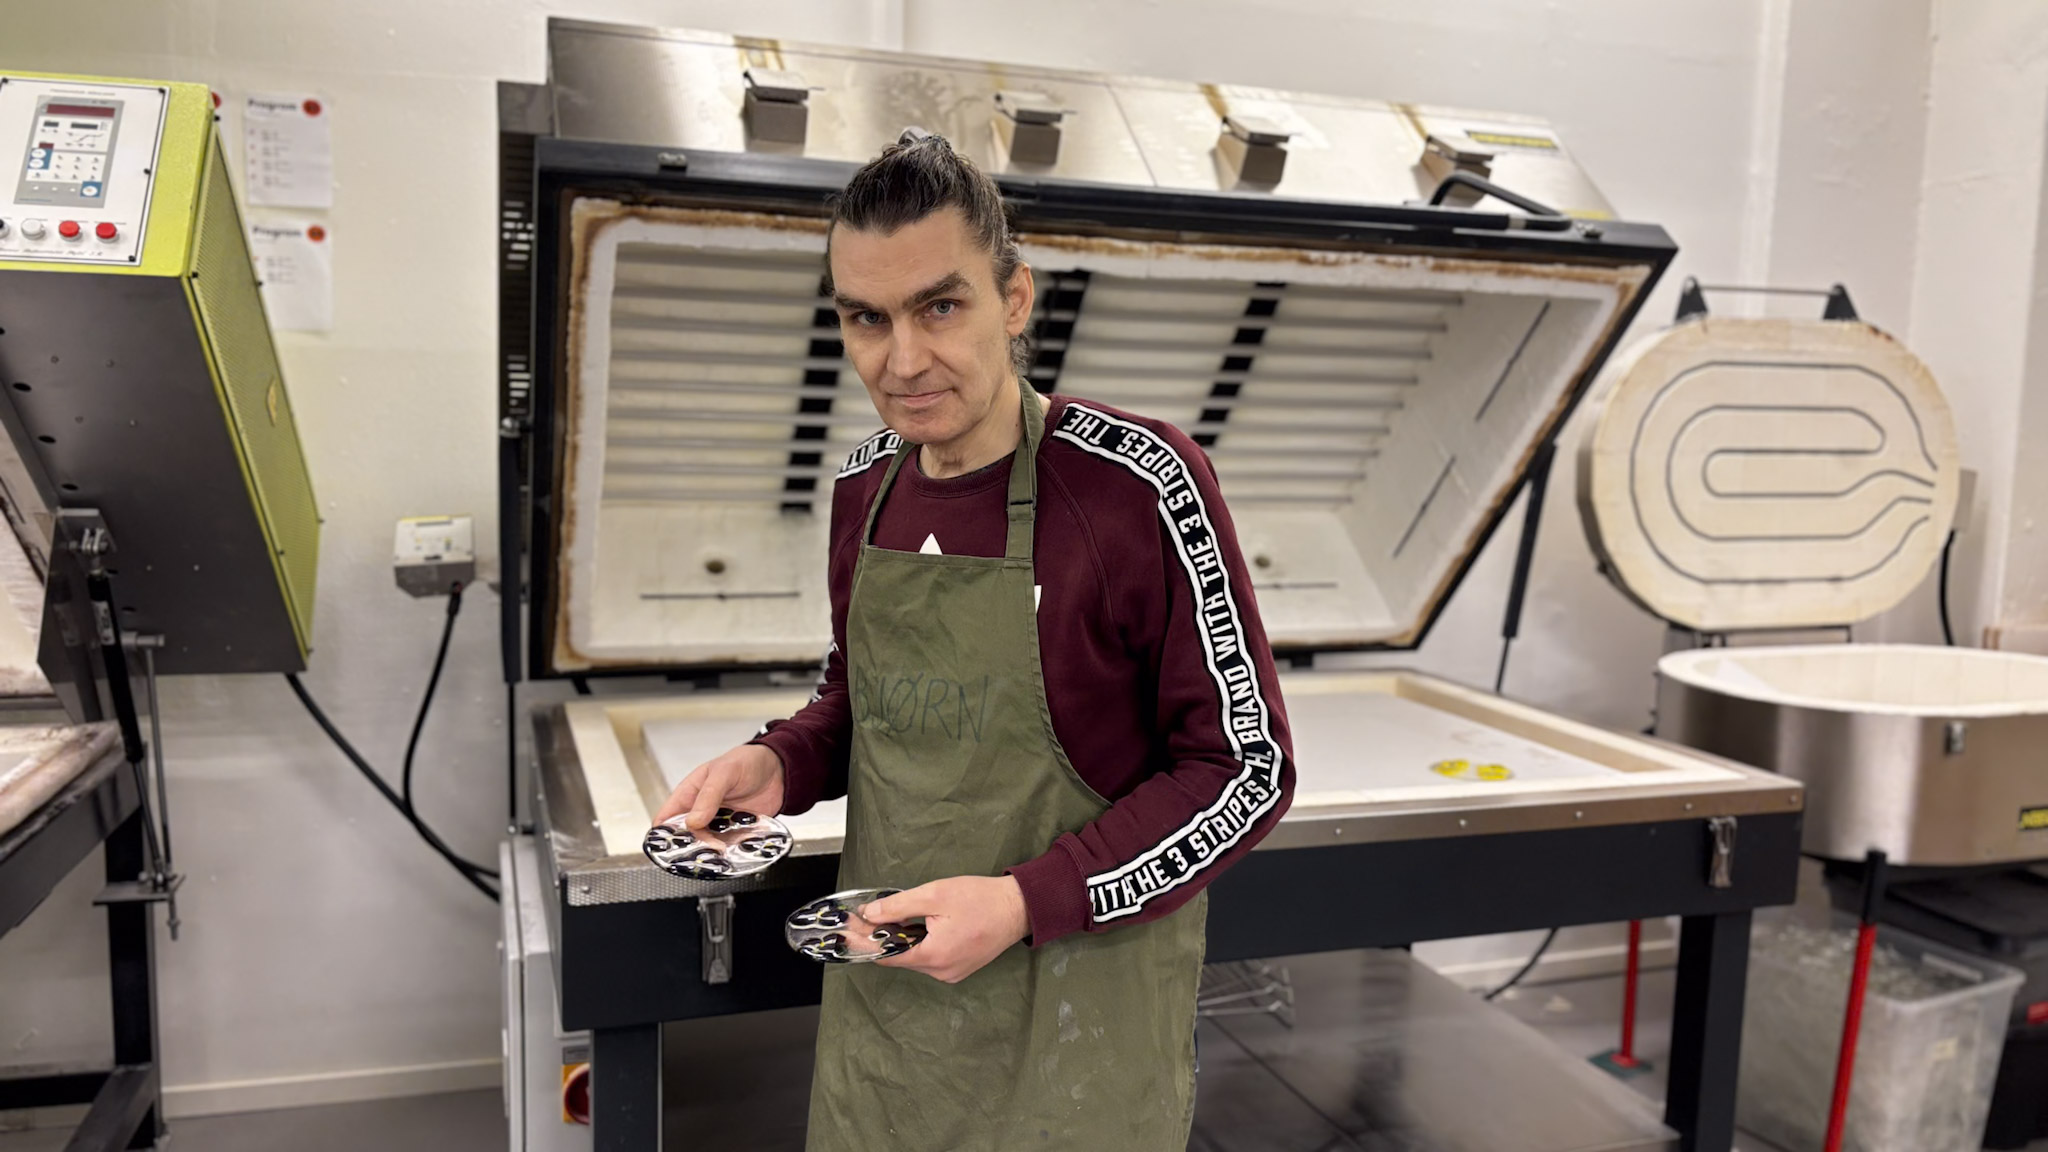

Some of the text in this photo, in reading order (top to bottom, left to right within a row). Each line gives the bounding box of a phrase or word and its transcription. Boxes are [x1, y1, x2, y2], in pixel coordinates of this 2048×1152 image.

[1062, 410, 1111, 447] THE
[1178, 513, 1202, 534] 3
[1187, 535, 1223, 588] THE
[1203, 591, 1238, 662] WITH
[1223, 664, 1265, 745] BRAND
[1166, 848, 1188, 873] 3
